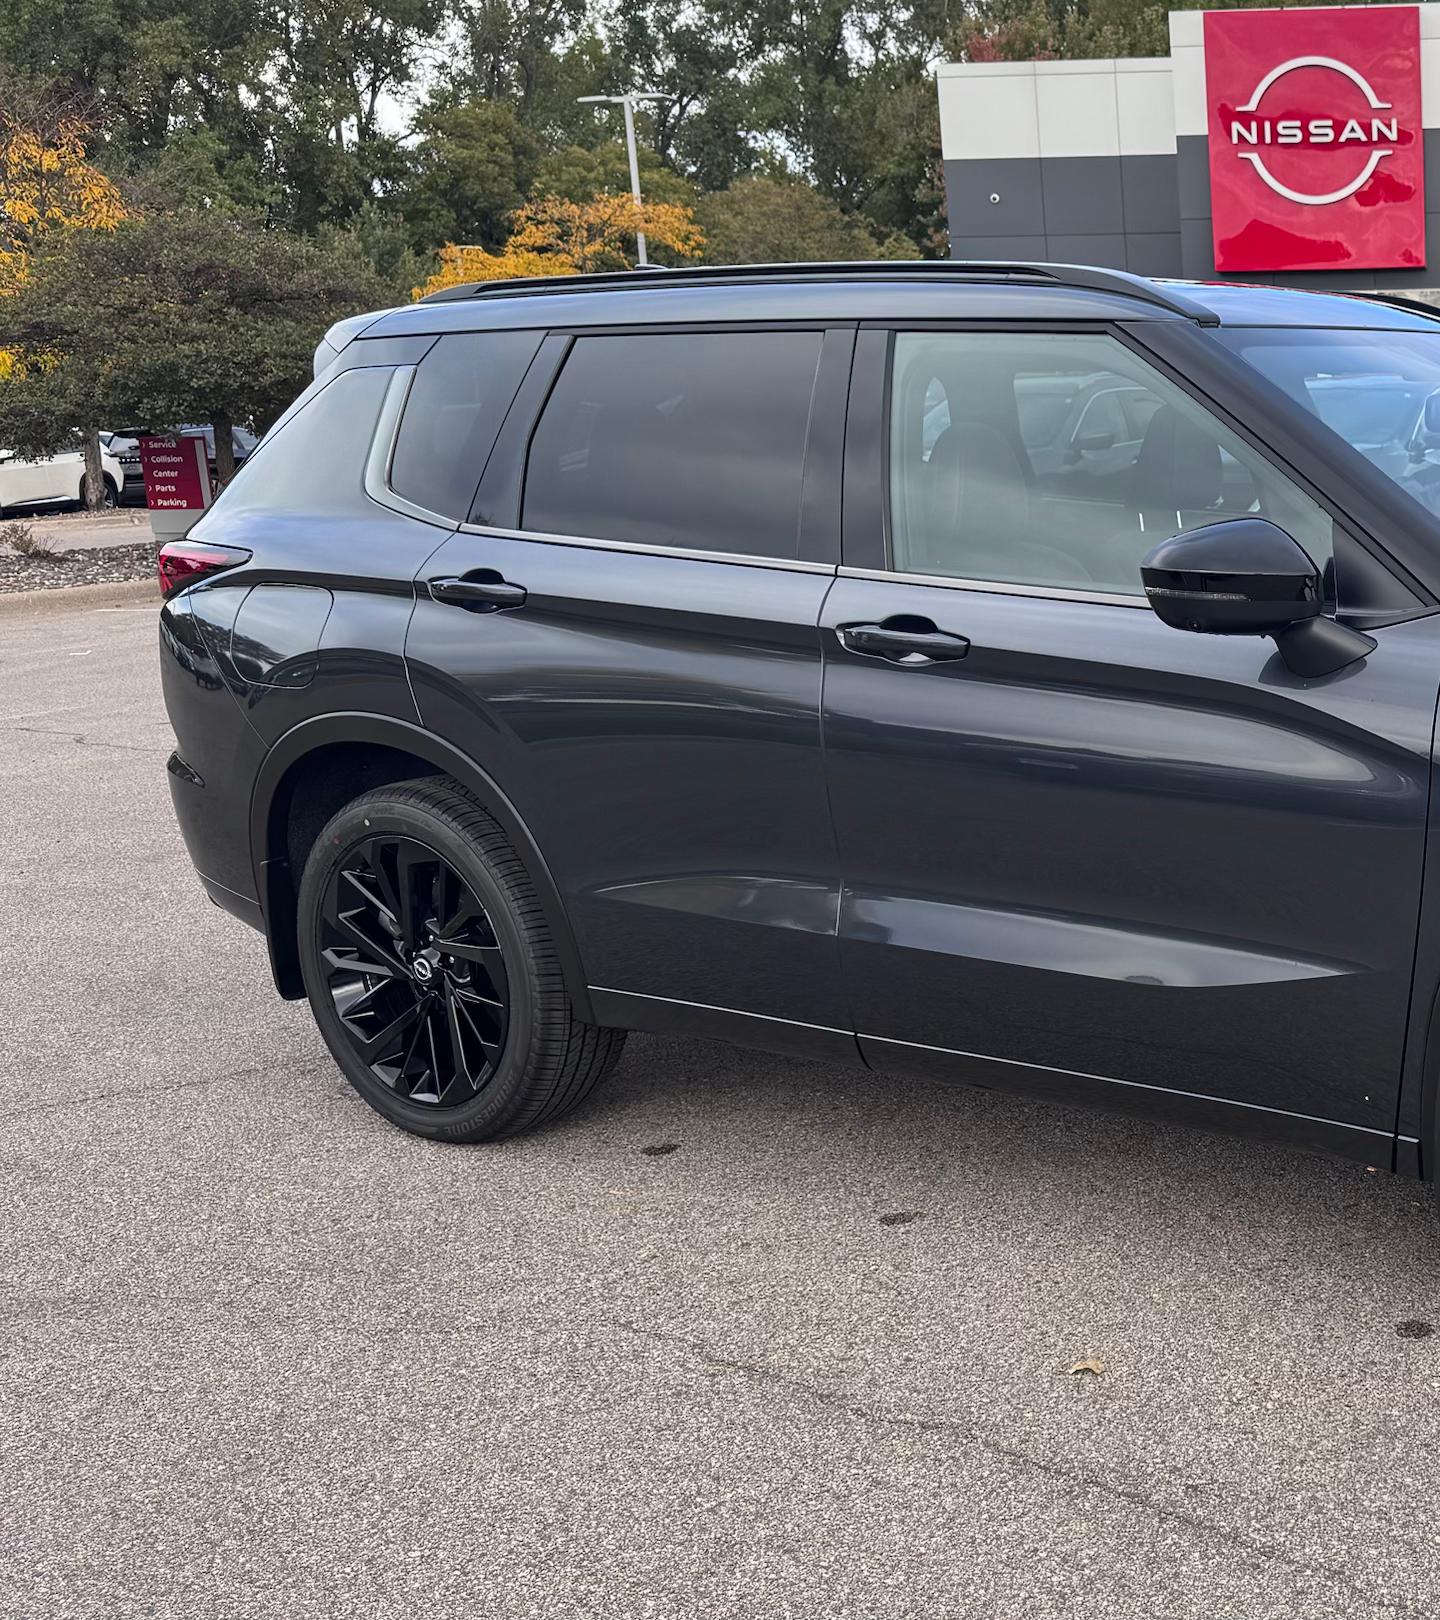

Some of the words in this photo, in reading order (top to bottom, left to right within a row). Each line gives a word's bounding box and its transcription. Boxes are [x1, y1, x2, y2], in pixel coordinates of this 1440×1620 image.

[1231, 118, 1398, 144] NISSAN
[149, 441, 177, 449] Service
[155, 484, 176, 492] Parts
[157, 499, 187, 507] Parking
